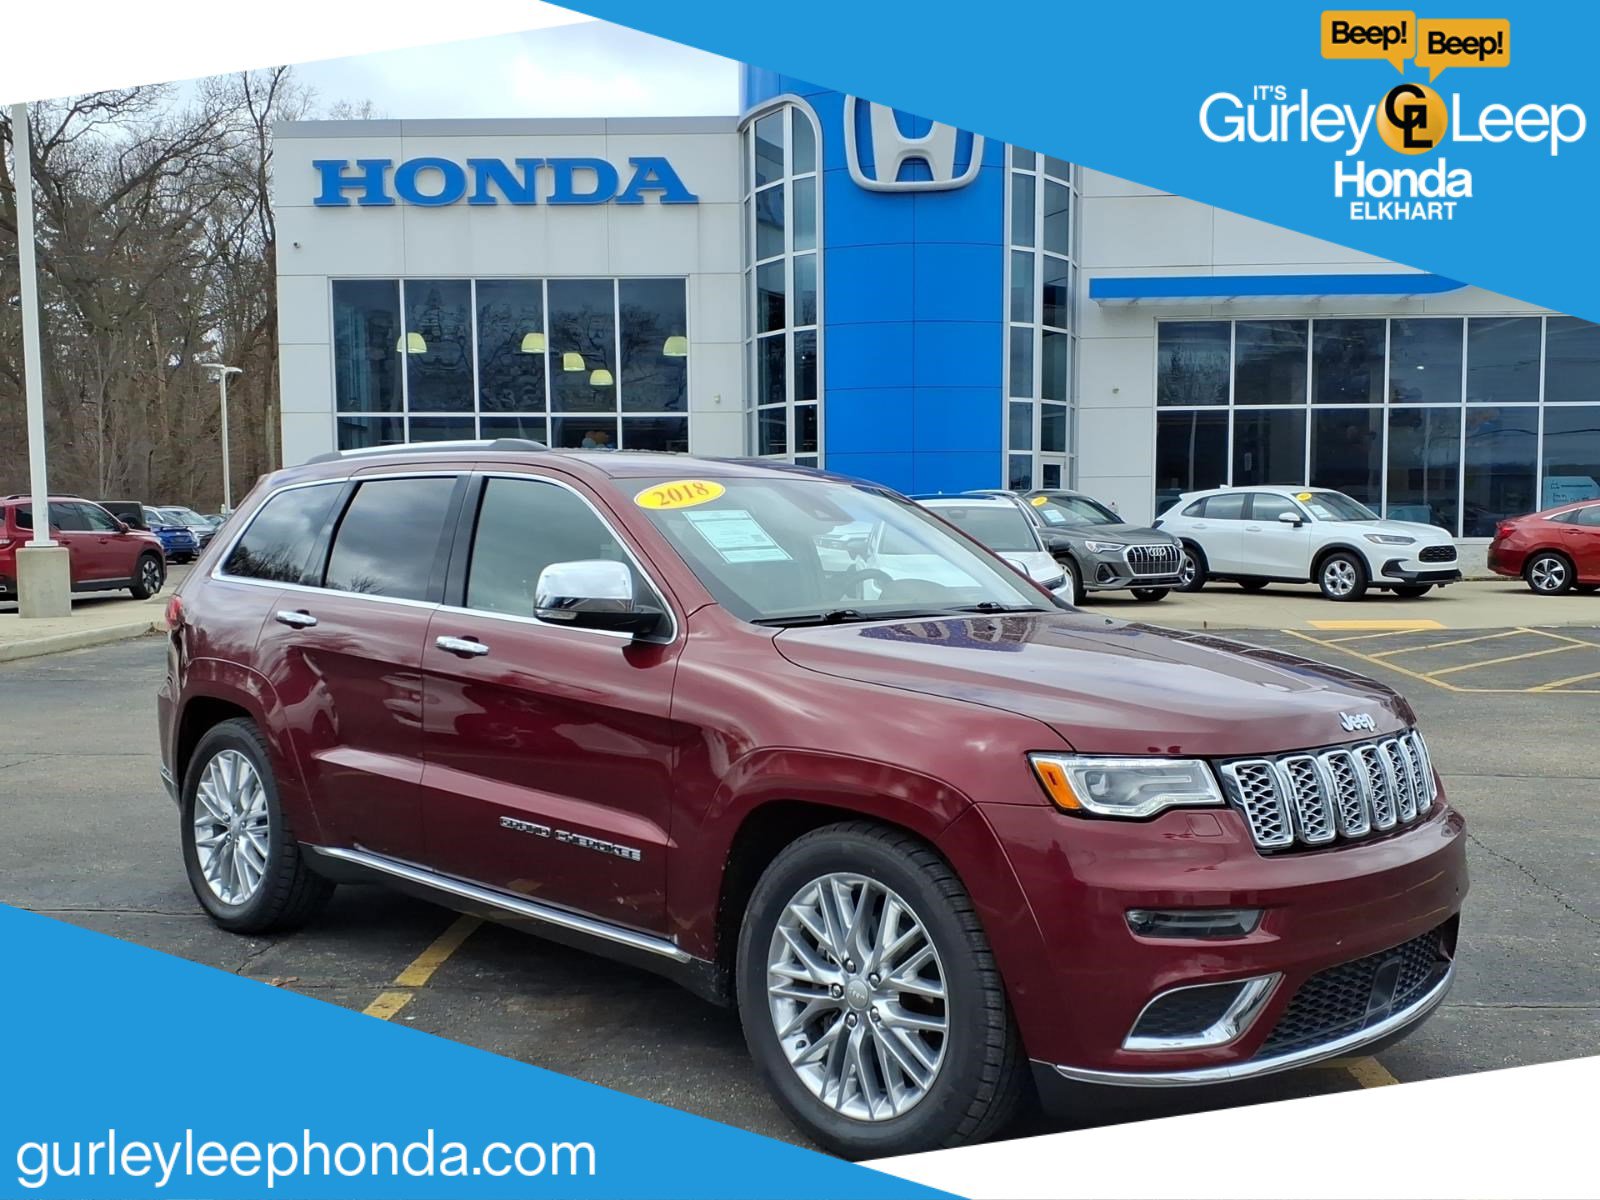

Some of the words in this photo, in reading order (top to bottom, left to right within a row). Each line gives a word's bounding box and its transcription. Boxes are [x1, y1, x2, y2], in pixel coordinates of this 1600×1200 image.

[311, 156, 700, 207] HONDA
[652, 481, 710, 507] 2018
[1339, 711, 1377, 732] Jeep
